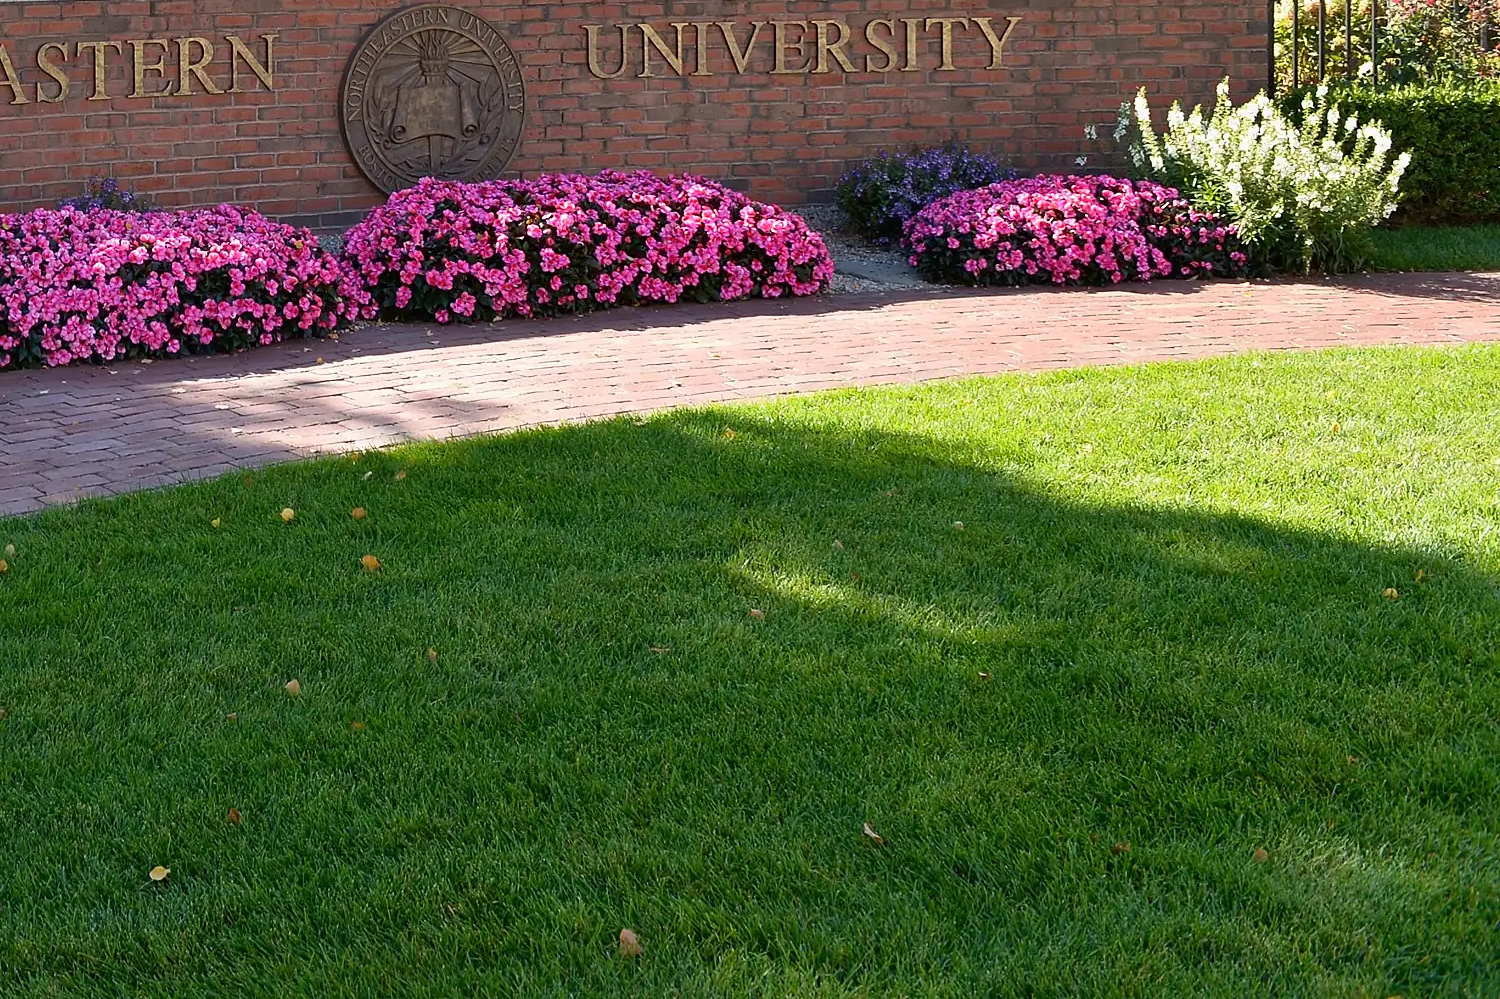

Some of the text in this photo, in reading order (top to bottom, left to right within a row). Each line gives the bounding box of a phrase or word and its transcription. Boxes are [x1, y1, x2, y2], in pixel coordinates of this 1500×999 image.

[347, 8, 450, 122] NORTHEASTERN
[458, 12, 525, 115] UNIVERSITY
[581, 15, 1024, 79] UNIVERSITY
